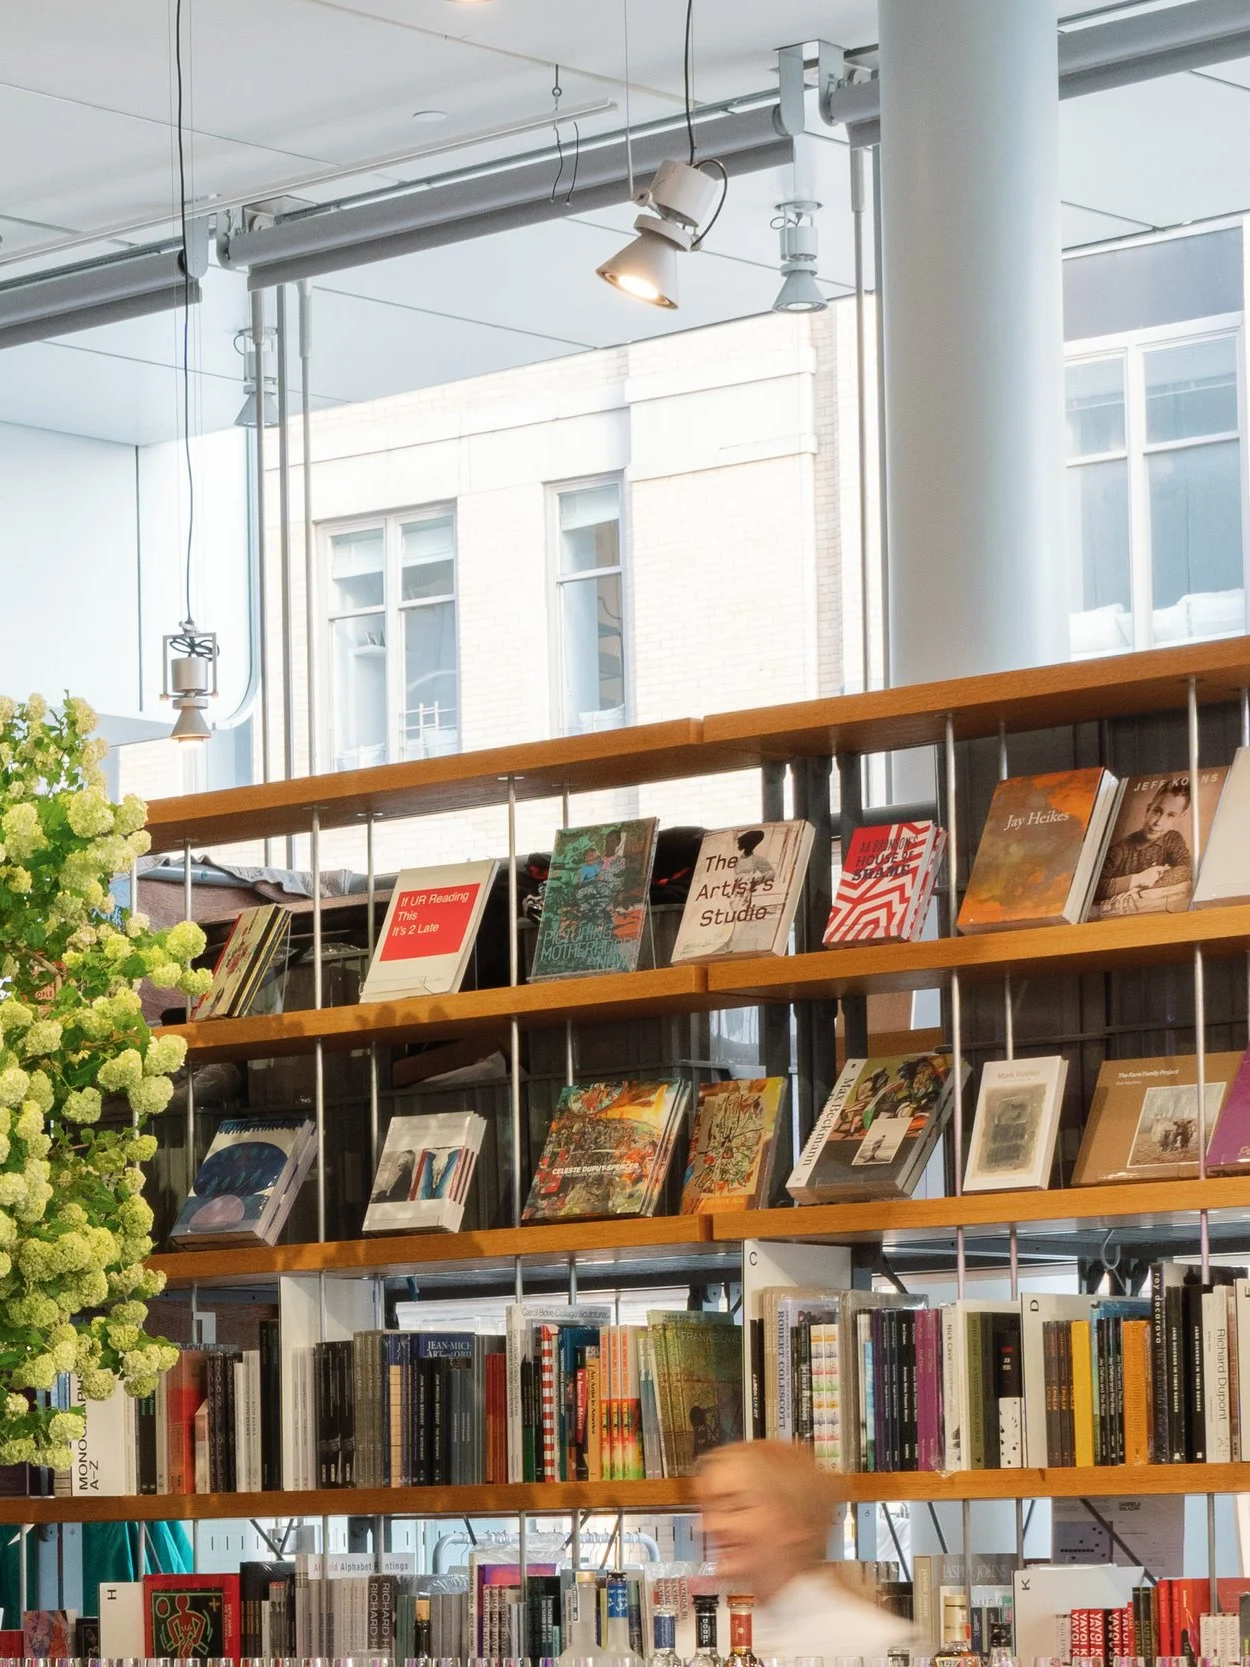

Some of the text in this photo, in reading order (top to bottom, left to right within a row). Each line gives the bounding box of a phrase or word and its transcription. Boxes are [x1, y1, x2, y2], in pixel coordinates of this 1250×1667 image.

[1134, 773, 1219, 792] JEFF KONS
[1003, 810, 1069, 831] Jay Heikes
[705, 854, 738, 873] The
[856, 850, 914, 867] HOUSE OF
[852, 864, 911, 881] SHAME
[695, 876, 775, 902] Artist's
[401, 891, 469, 907] If UR Reading
[397, 911, 418, 921] This
[699, 904, 768, 927] Studio
[392, 923, 439, 937] It's 2 Late
[543, 923, 613, 945] PICTURING
[1142, 1070, 1159, 1078] Family
[1159, 1069, 1179, 1077] Project
[803, 1078, 855, 1166] Max Beckmann
[552, 1163, 640, 1175] CELESTE DUPUY-SPENCER
[749, 1251, 758, 1266] C
[1153, 1273, 1163, 1290] roy
[1030, 1298, 1040, 1312] D
[1153, 1295, 1163, 1344] decarava
[577, 1372, 583, 1380] An
[591, 1369, 597, 1378] An
[778, 1310, 786, 1429] ROBERT COLESCOTT
[1216, 1328, 1227, 1422] Richard Dupont
[77, 1374, 88, 1491] MONOPH
[340, 1562, 372, 1573] Alphabet
[943, 1564, 975, 1579] JASPR
[1021, 1578, 1030, 1590] K
[107, 1589, 117, 1600] H
[370, 1582, 378, 1636] RICHARD
[382, 1582, 391, 1636] RICHARD
[1071, 1612, 1080, 1645] YAYOI
[1080, 1612, 1088, 1645] YAYOI
[1094, 1612, 1103, 1645] YAYOI
[1112, 1612, 1120, 1645] YAYOI
